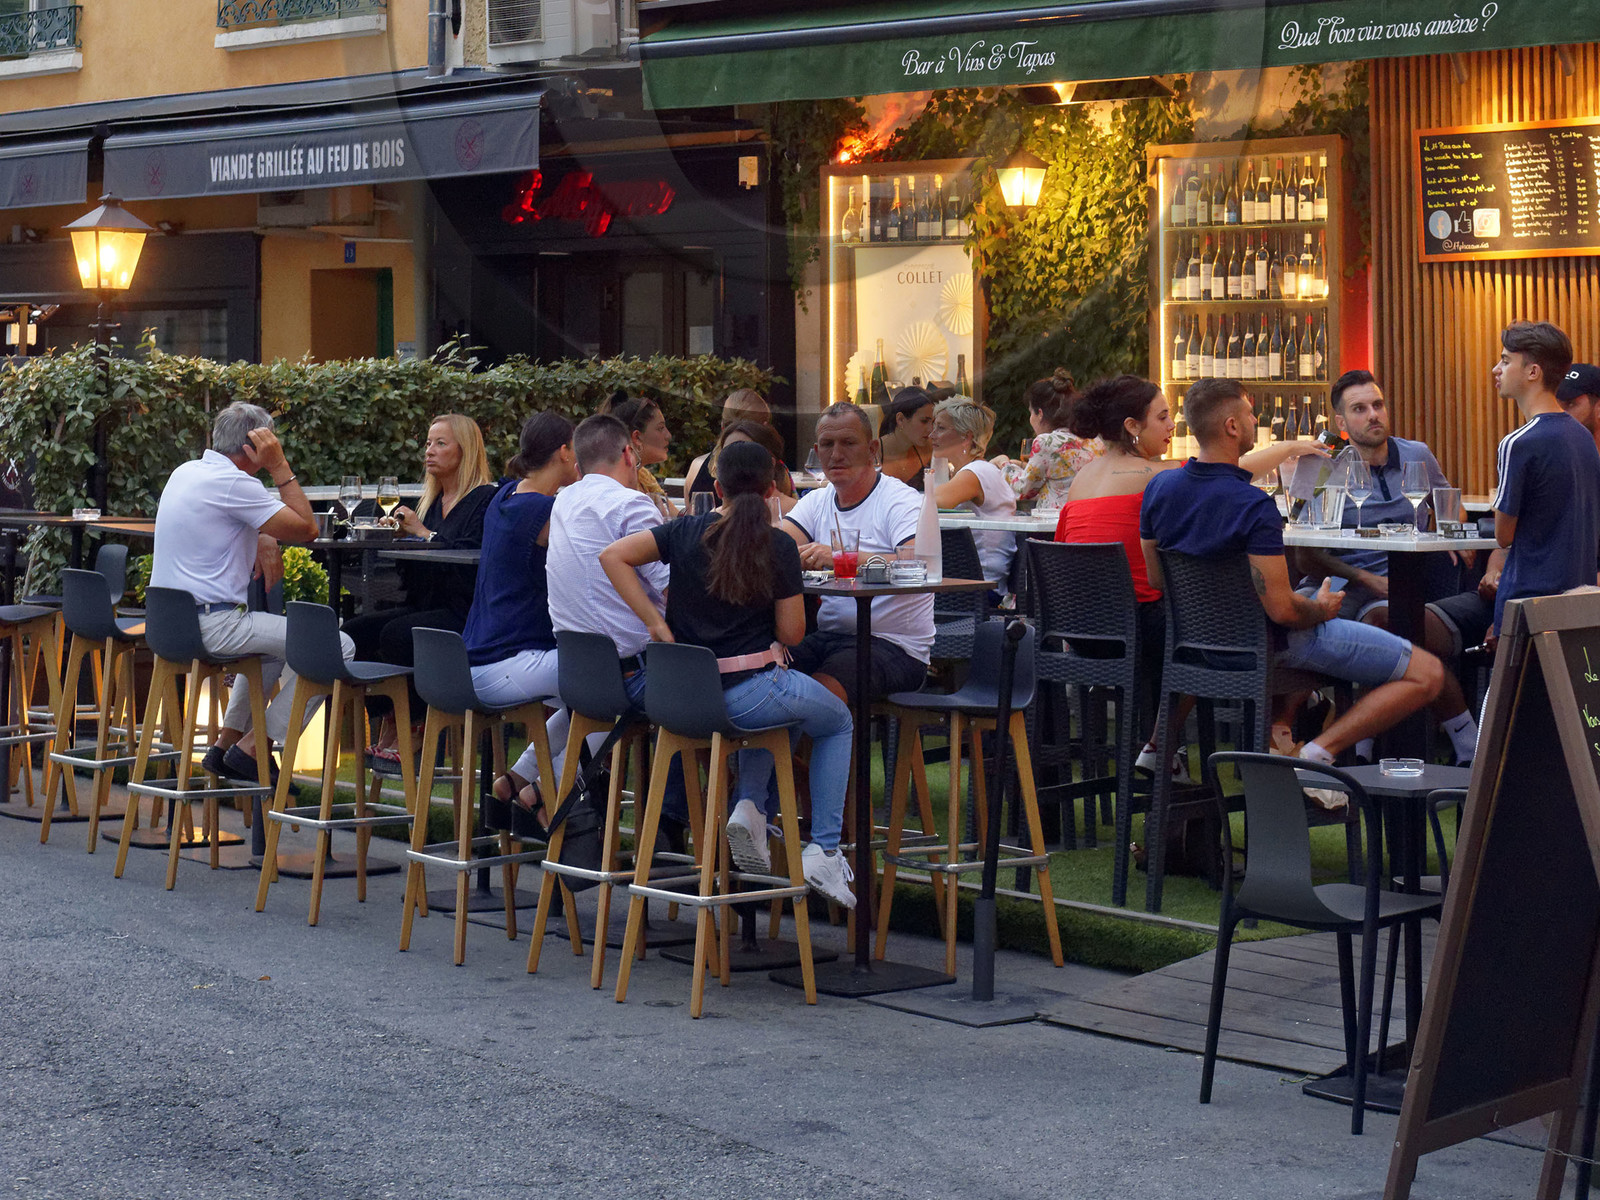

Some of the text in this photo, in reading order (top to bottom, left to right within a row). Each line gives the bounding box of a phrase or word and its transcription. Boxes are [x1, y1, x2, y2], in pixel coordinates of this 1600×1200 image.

[1278, 17, 1331, 50] Quel
[1328, 16, 1355, 45] bon
[1358, 20, 1383, 42] vin
[1386, 22, 1422, 39] vous
[901, 40, 1056, 76] Bar à Vins & Tapas
[210, 138, 405, 182] VIANDE GRILLÉE AU FEU DE BOIS
[897, 271, 943, 285] COLLET
